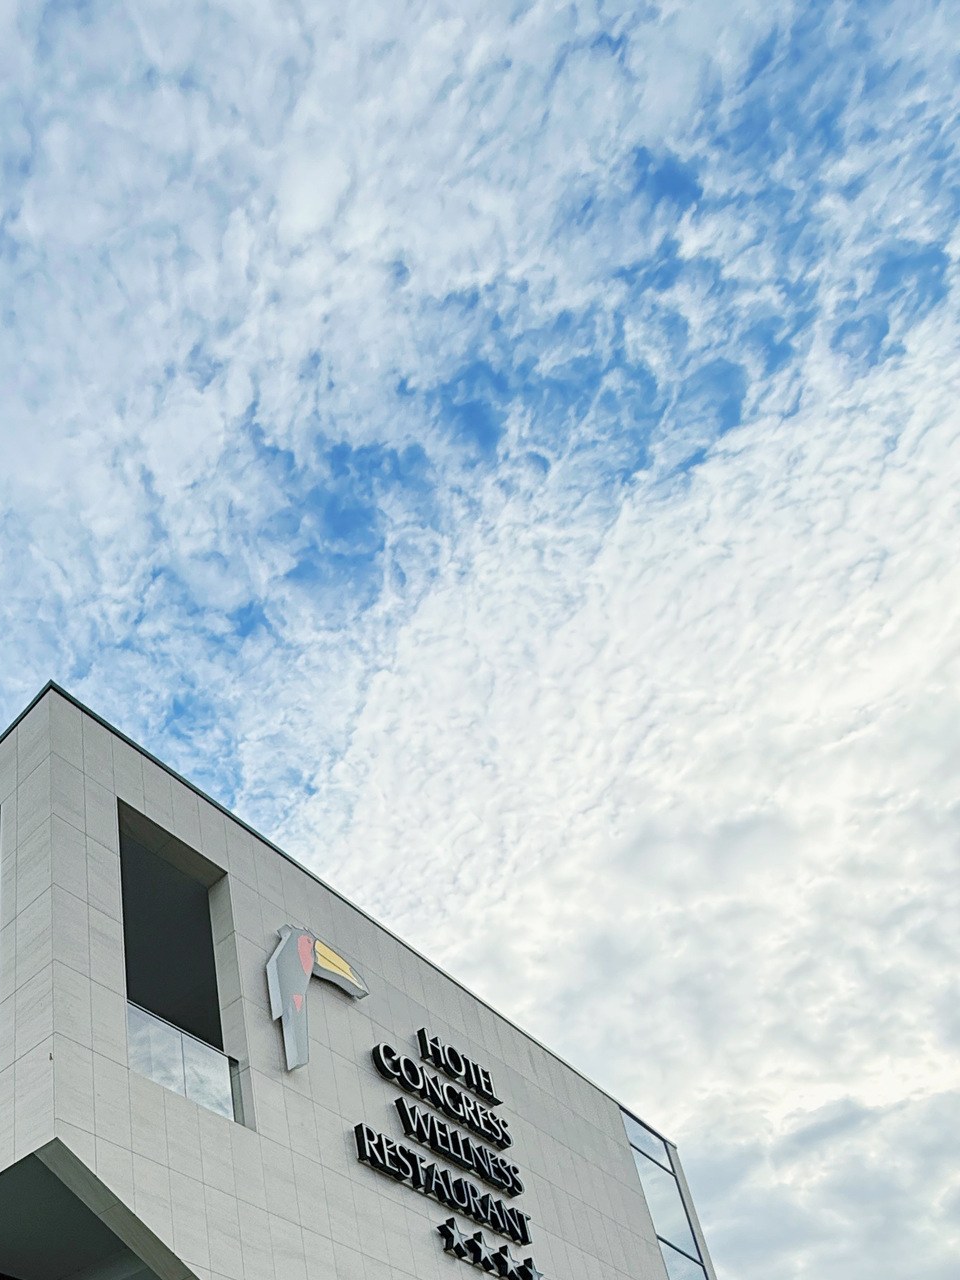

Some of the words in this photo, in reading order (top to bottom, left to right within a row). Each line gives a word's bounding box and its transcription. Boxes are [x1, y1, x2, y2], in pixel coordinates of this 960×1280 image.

[373, 1042, 514, 1150] CONGRESS
[418, 1028, 503, 1104] HOTEL
[356, 1123, 532, 1244] RESTAURANT
[396, 1097, 525, 1196] WELLNESS
